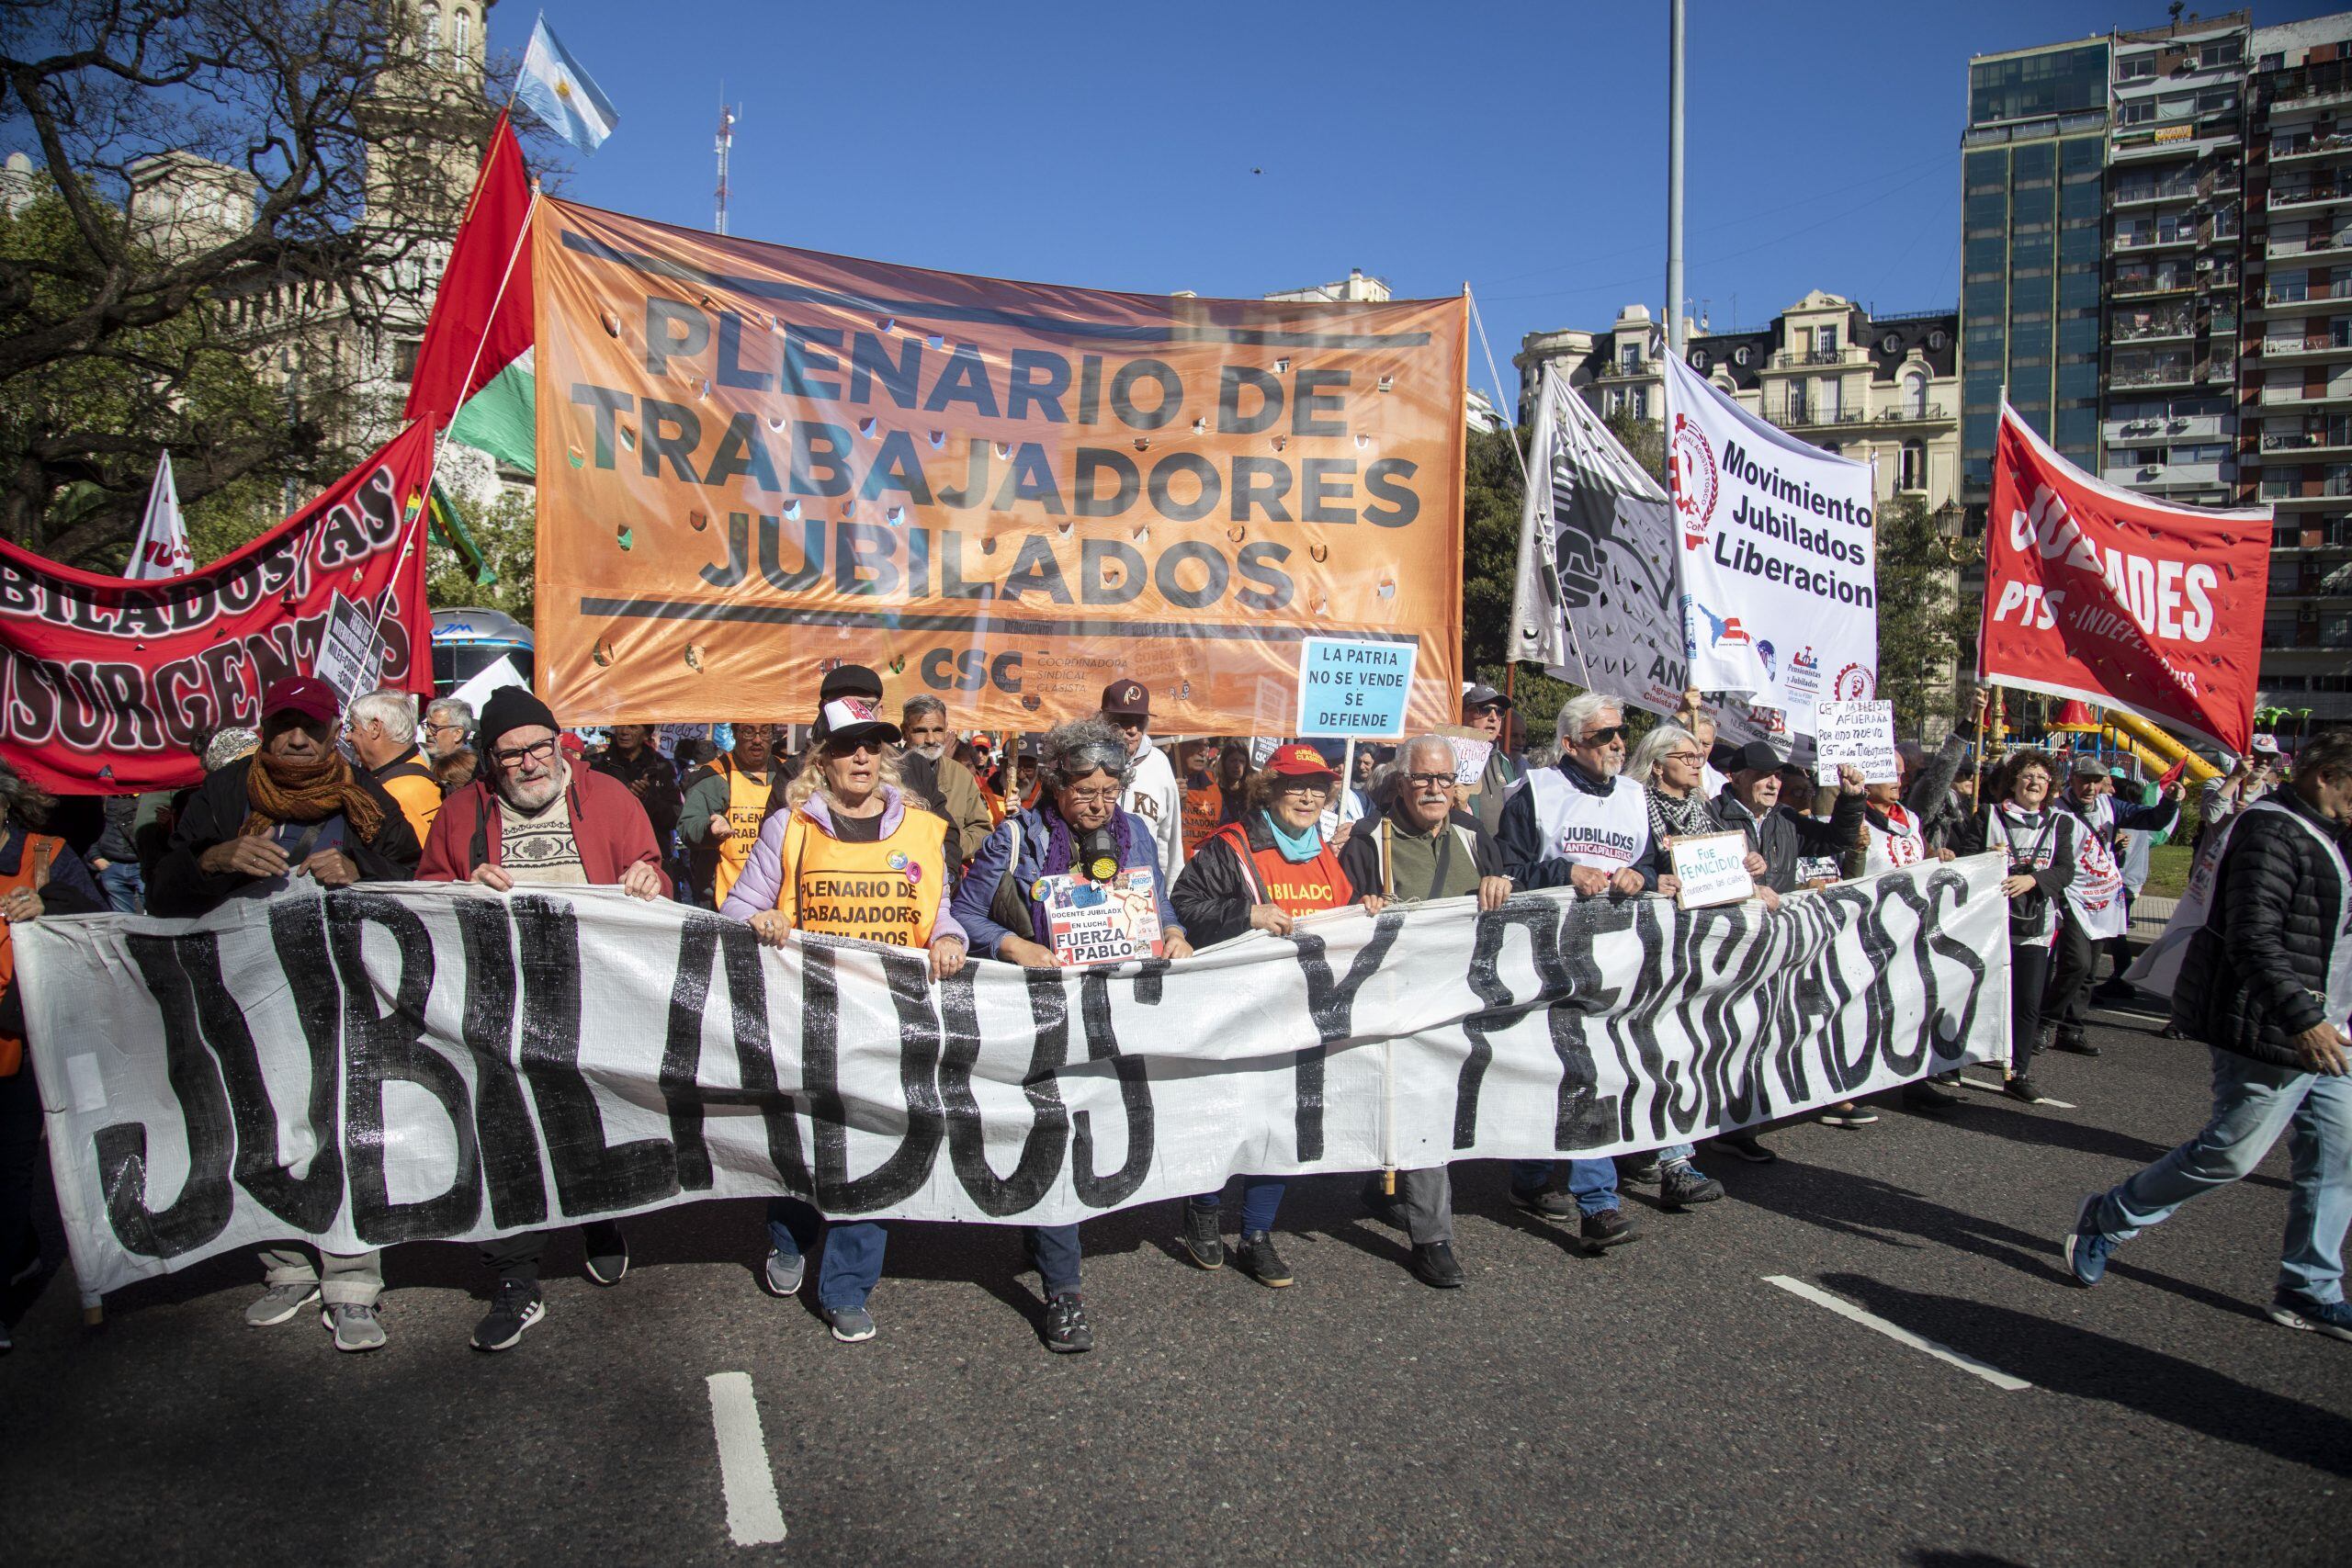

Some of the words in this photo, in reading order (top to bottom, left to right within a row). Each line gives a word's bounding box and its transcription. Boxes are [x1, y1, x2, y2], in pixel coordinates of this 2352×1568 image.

[645, 296, 1183, 431] PLENARIO
[1218, 366, 1352, 438] DE
[571, 384, 1420, 529] TRABAJADORES
[1701, 477, 1711, 506] TOSCO
[1722, 439, 1872, 529] Movimiento
[1733, 494, 1866, 567] Jubilados
[698, 513, 1294, 612] JUBILADOS
[1714, 532, 1873, 608] Liberacion
[1993, 581, 2066, 630] PTS
[1037, 657, 1129, 669] COORDINADORA
[1323, 648, 1342, 661] LA
[1348, 649, 1398, 666] PATRIA
[921, 648, 1023, 693] CSC
[1036, 671, 1088, 681] SINDICAL
[1309, 671, 1330, 684] NO
[1334, 671, 1354, 686] SE
[1359, 672, 1404, 687] VENDE
[1787, 663, 1822, 678] Pensionistas
[1035, 683, 1087, 694] CLASISTA
[1791, 675, 1818, 689] Jubilados
[1344, 693, 1364, 706] SE
[1644, 692, 1672, 708] Clasista
[1652, 684, 1683, 703] Agrupaci
[1319, 712, 1388, 728] DEFIENDE
[1731, 717, 1753, 734] NUEVA
[1751, 728, 1792, 749] IZQUIERDA
[1564, 827, 1634, 852] JUBILADXS
[1565, 842, 1632, 863] ANTICAPITALISTAS
[1697, 848, 1716, 861] FUE
[1679, 855, 1740, 881] FEMICIDIO
[897, 881, 918, 899] DE
[1087, 908, 1122, 916] JUBILADX
[1056, 928, 1126, 948] FUERZA
[1074, 942, 1132, 961] PABLO
[98, 891, 1170, 1258] JUBILADOS
[1288, 911, 1406, 1162] Y
